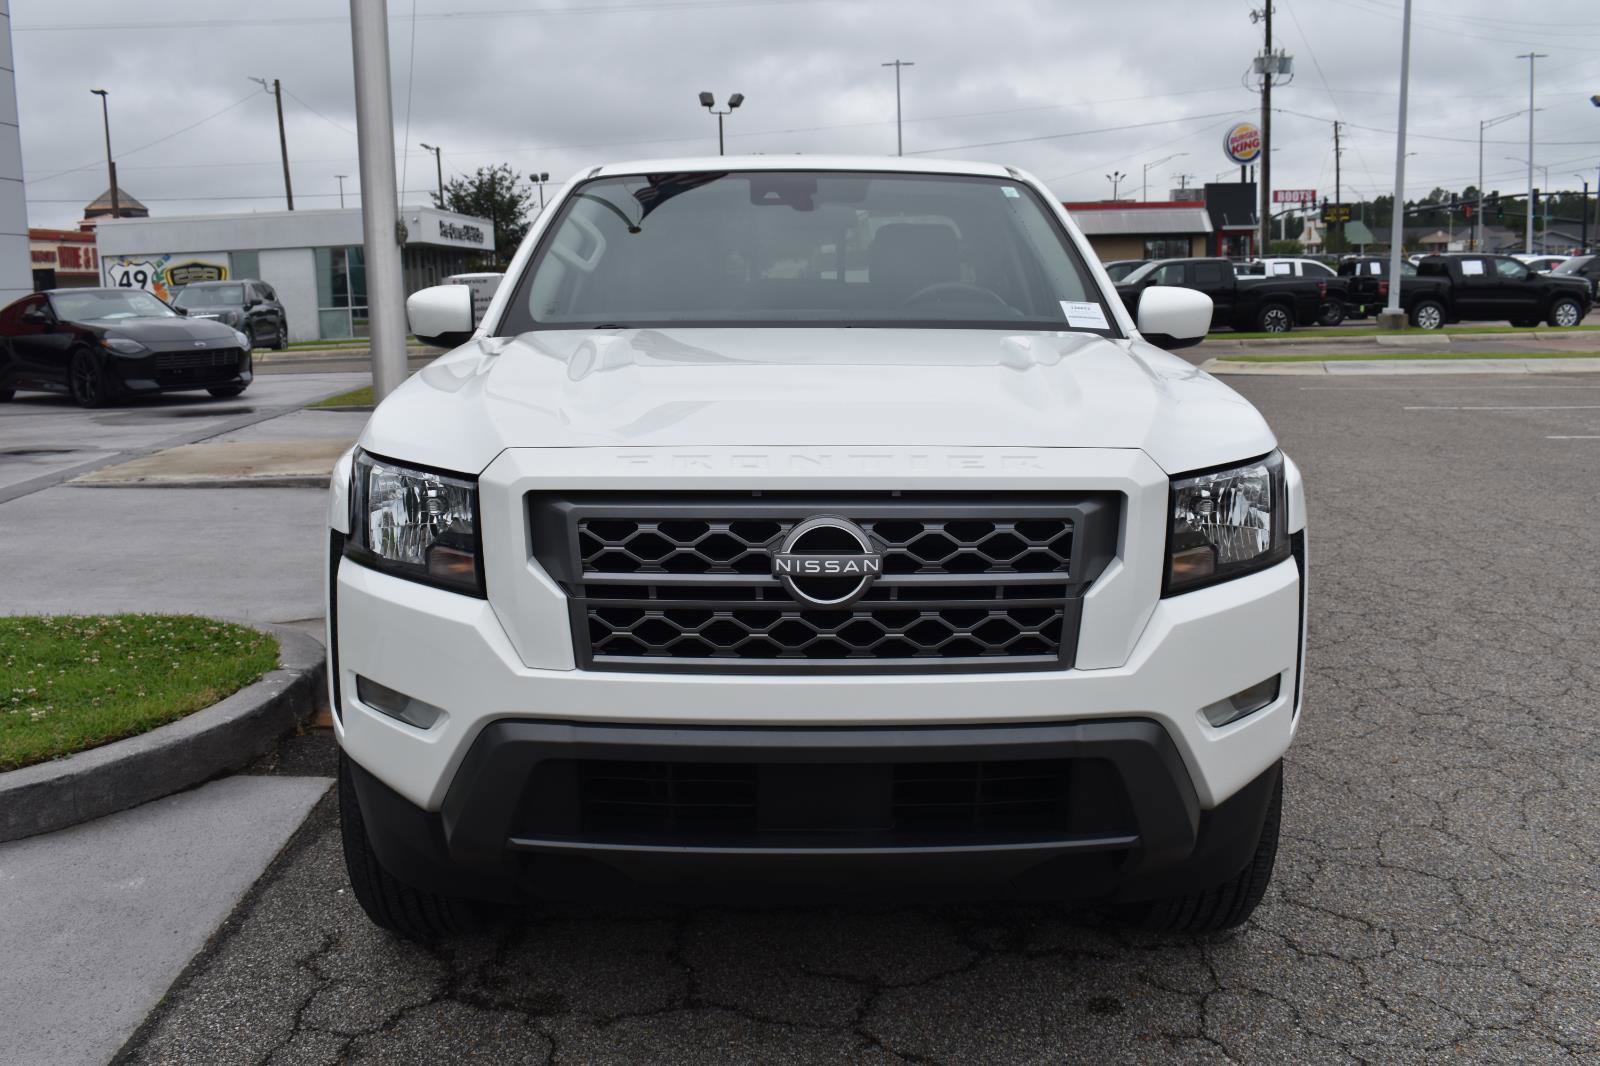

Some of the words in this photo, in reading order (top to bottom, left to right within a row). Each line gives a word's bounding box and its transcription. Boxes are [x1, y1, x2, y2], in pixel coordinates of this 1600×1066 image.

[1231, 130, 1258, 143] BURGER
[1232, 138, 1260, 155] KING
[1277, 191, 1312, 203] BOOTS
[118, 269, 148, 290] 49
[616, 454, 1045, 471] FRONTIER
[775, 558, 879, 573] NISSAN
